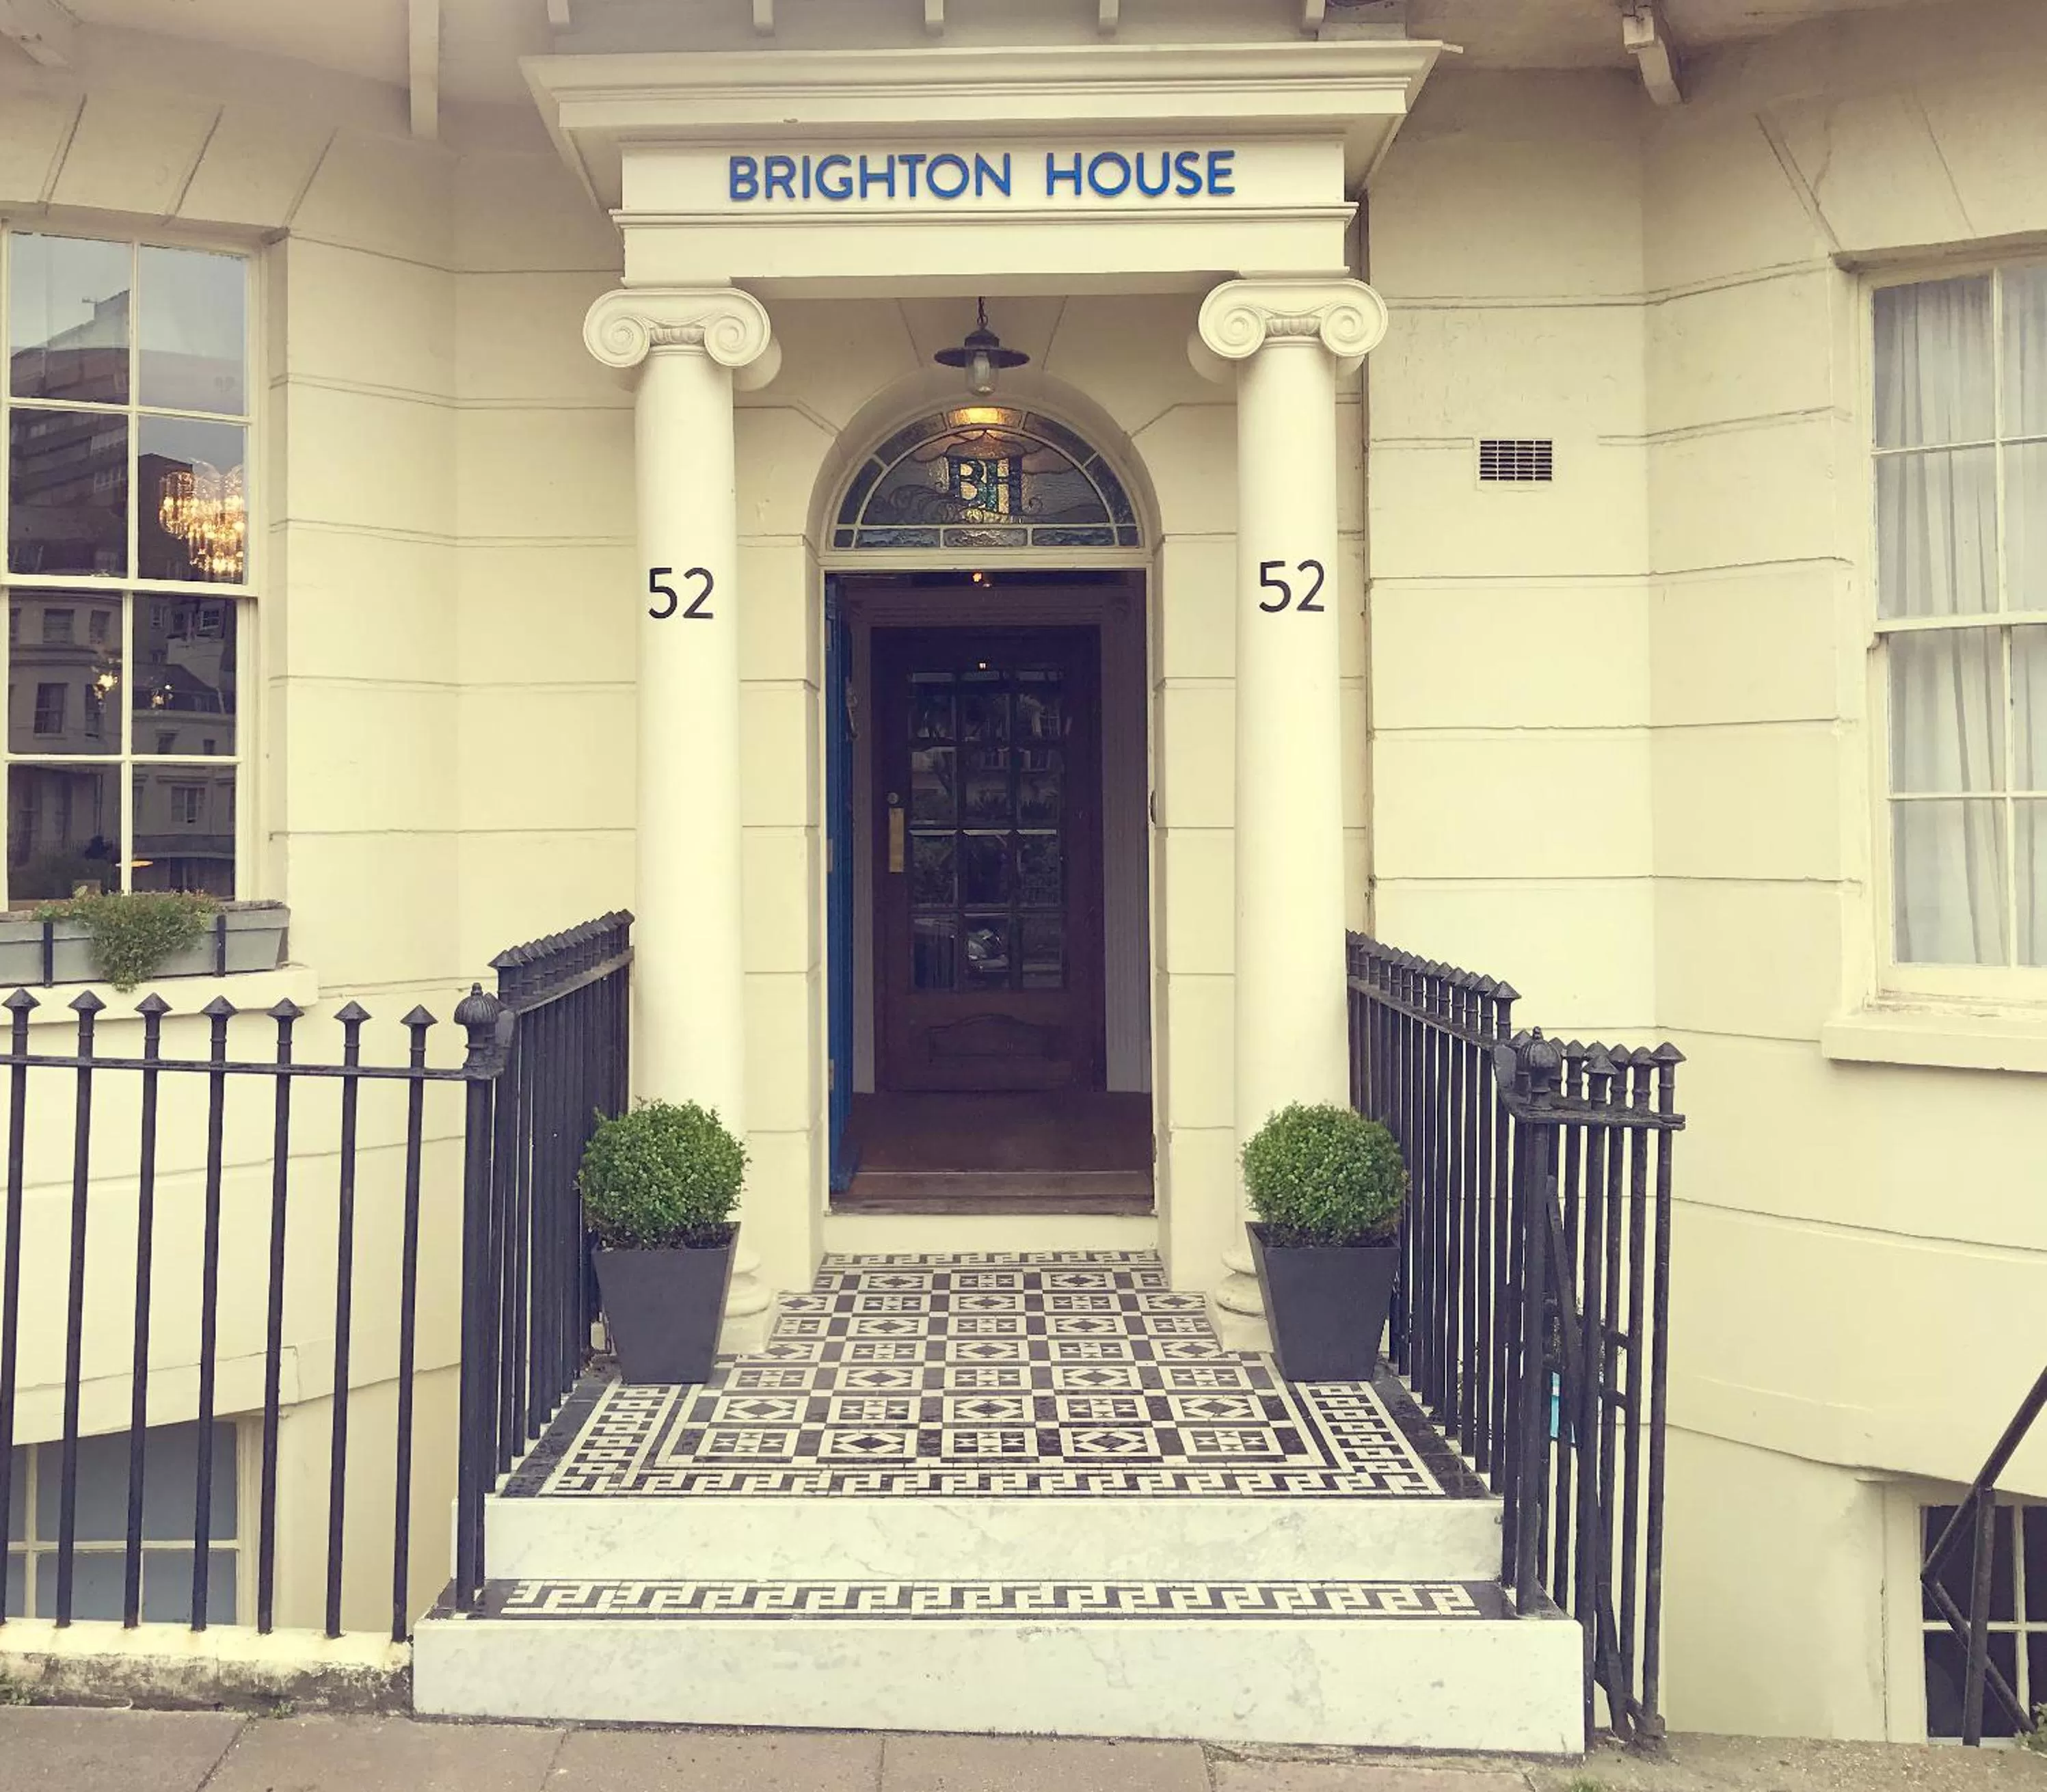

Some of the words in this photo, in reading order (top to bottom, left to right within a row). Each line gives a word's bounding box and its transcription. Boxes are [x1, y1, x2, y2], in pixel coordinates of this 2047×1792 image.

[729, 153, 1012, 201] BRIGHTON
[1046, 150, 1236, 198] HOUSE
[648, 567, 714, 619] 52
[1259, 559, 1324, 613] 52
